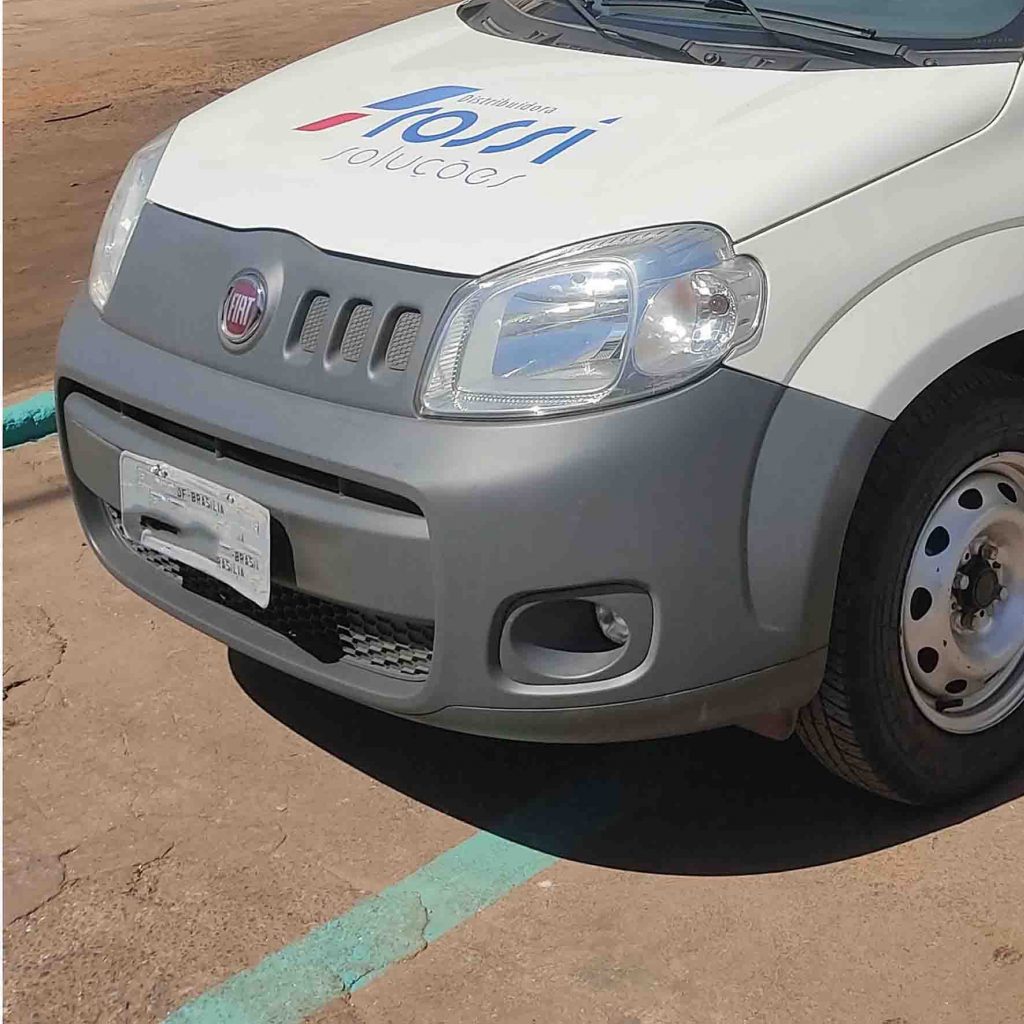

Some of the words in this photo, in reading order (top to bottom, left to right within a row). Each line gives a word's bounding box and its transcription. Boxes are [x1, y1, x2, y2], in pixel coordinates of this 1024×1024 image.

[457, 94, 558, 114] Distribuidora
[362, 107, 623, 165] rossi
[321, 146, 527, 188] soluções
[227, 292, 256, 326] FIAT
